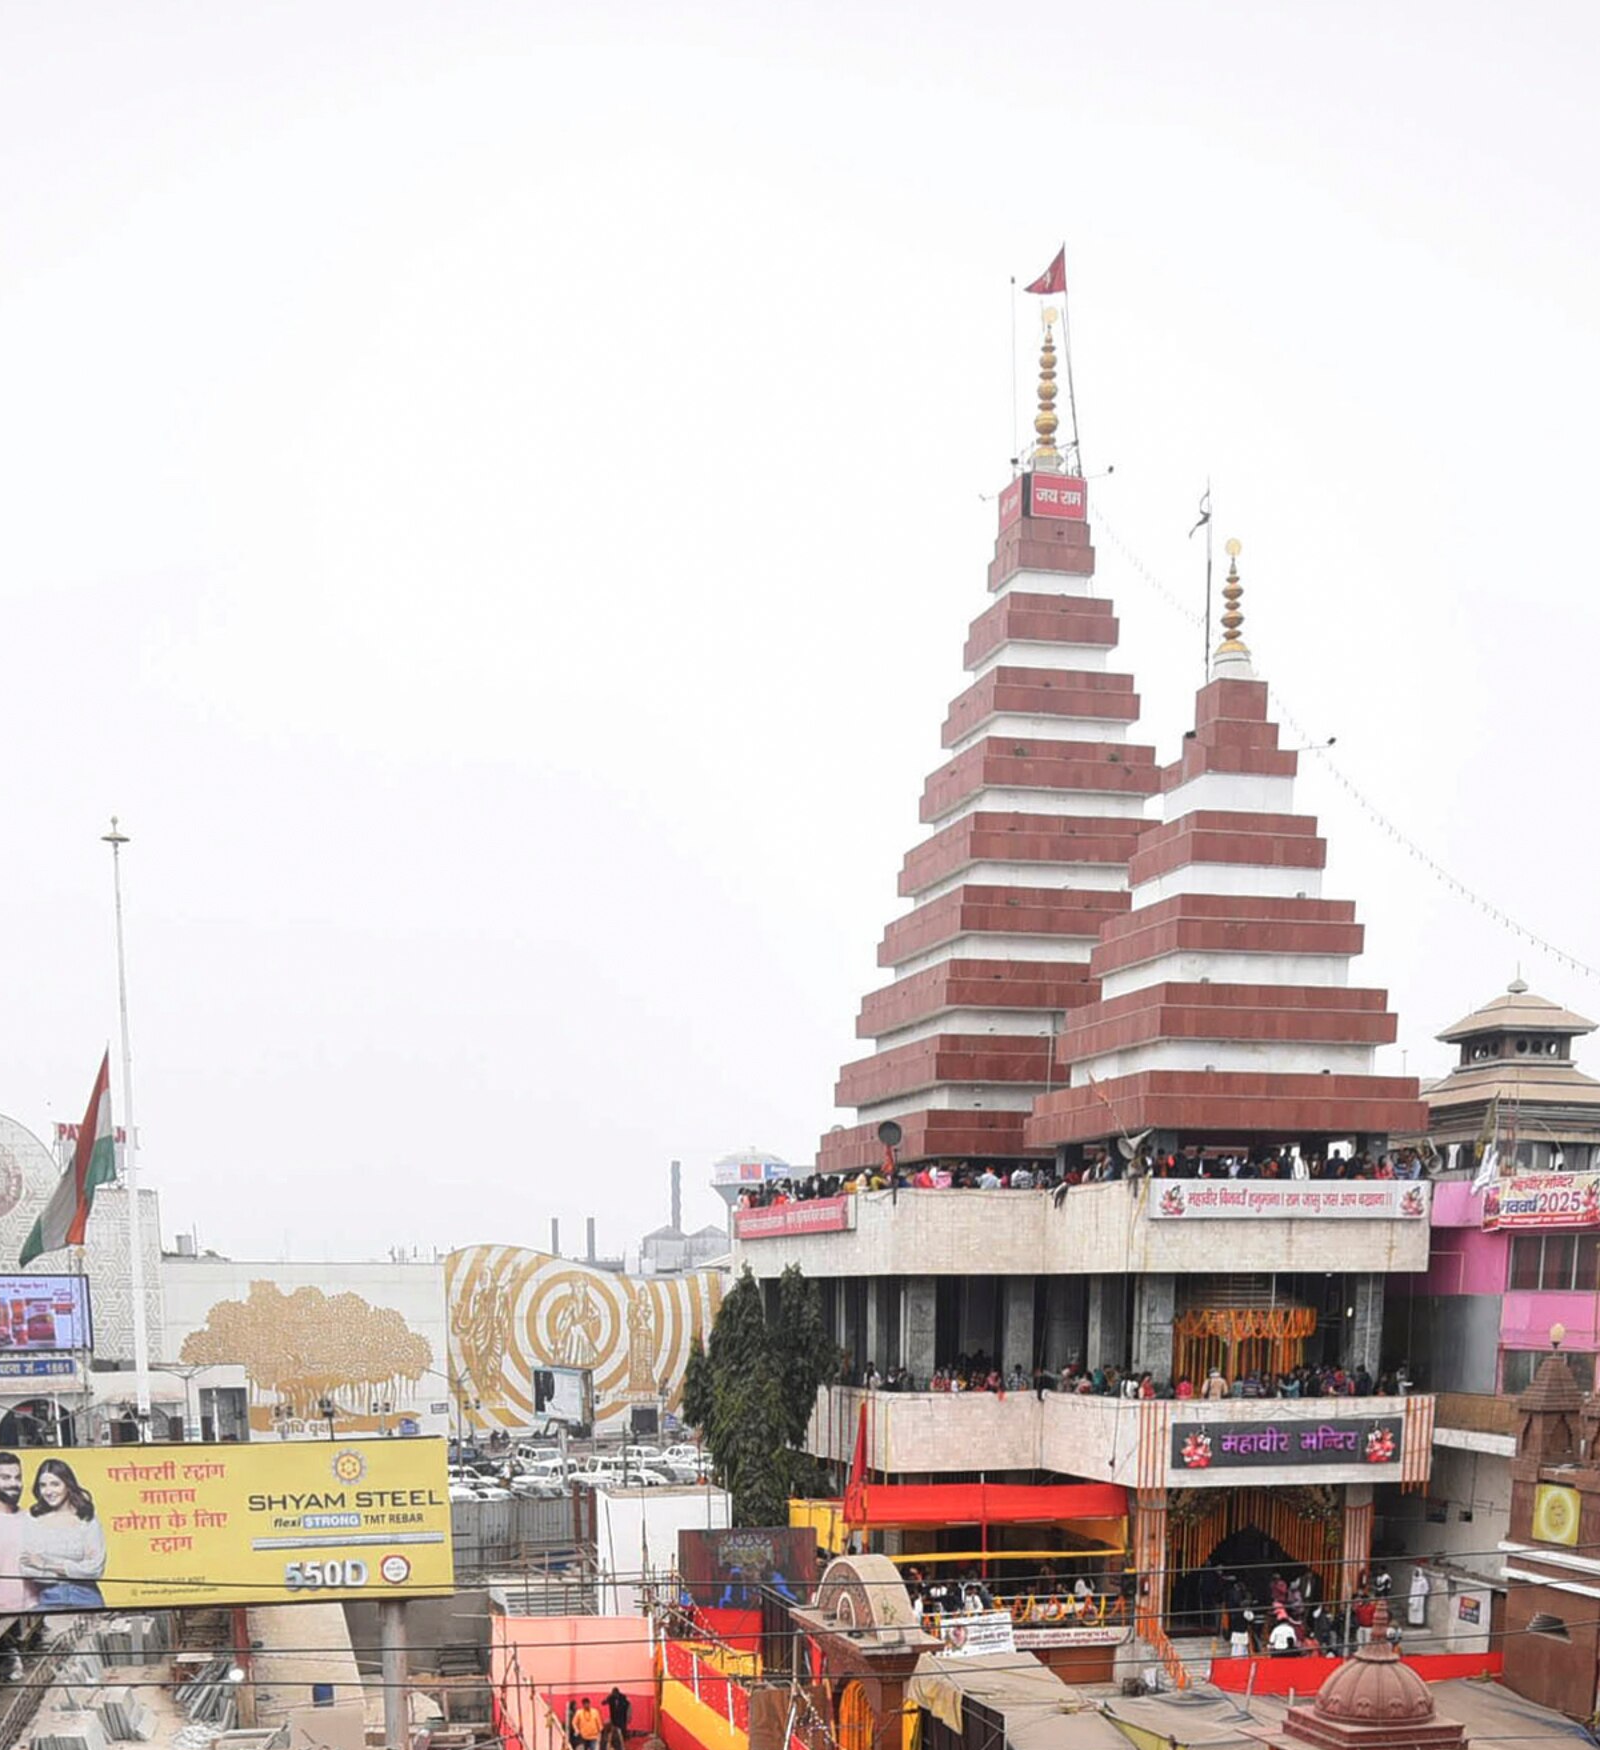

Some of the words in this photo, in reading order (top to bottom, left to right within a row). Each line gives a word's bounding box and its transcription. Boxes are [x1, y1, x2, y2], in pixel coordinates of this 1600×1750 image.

[1538, 1191, 1582, 1213] 2025
[1220, 1426, 1291, 1455] महावीर
[1299, 1424, 1358, 1451] मन्दिर
[139, 1487, 196, 1505] मतलब
[247, 1492, 346, 1512] SHYAM
[354, 1489, 445, 1508] STEEL
[167, 1509, 188, 1530] के
[273, 1515, 302, 1530] flexi
[304, 1514, 361, 1529] STRONG
[363, 1513, 386, 1526] TMT
[388, 1512, 425, 1526] REBAR
[283, 1558, 369, 1593] 550D
